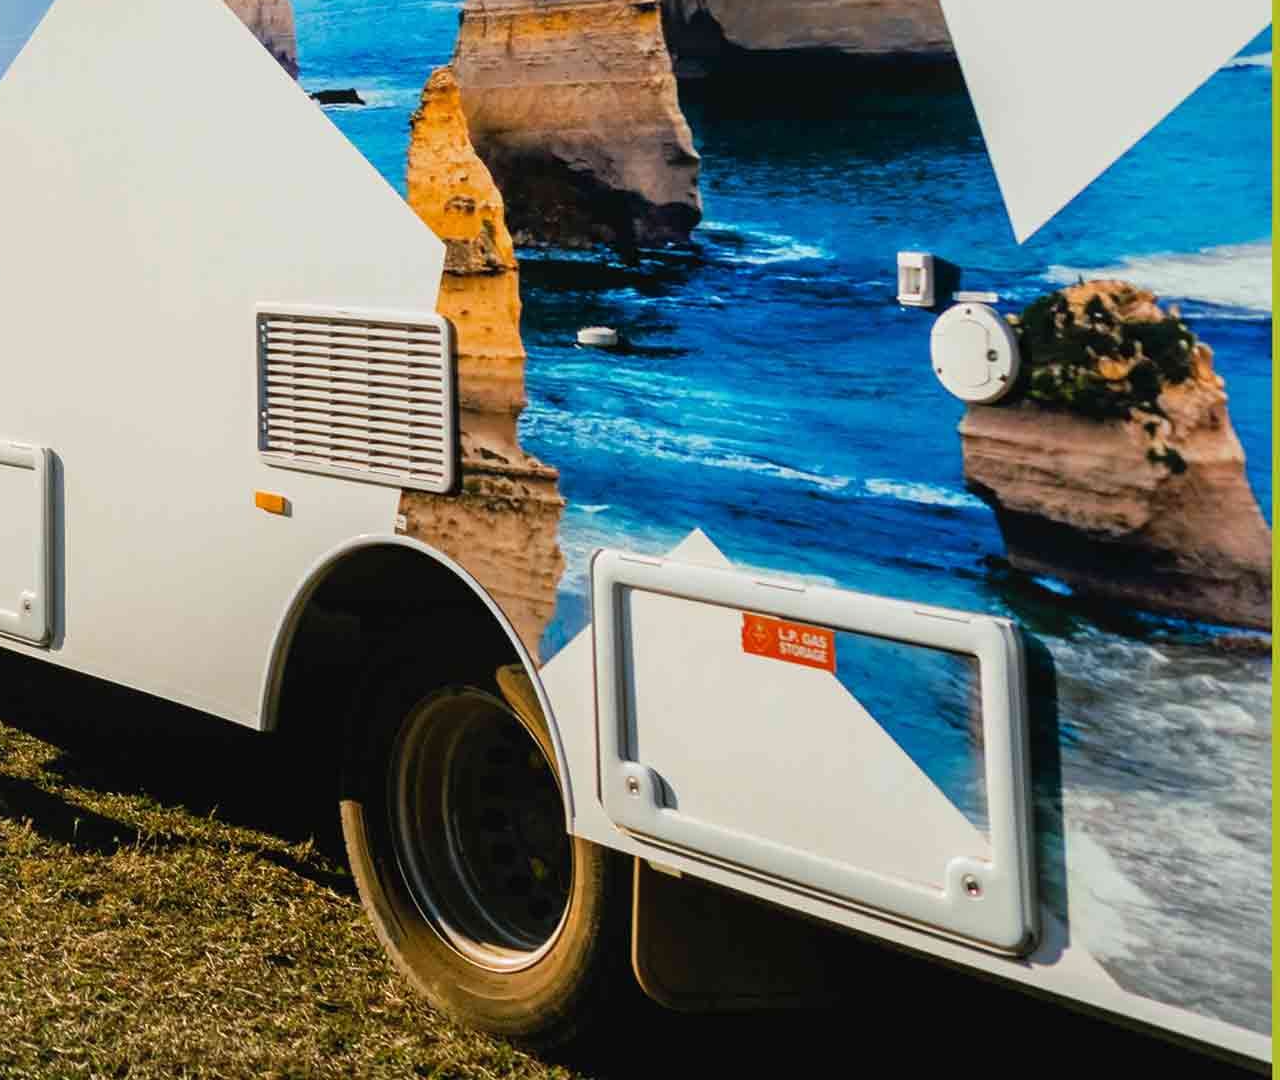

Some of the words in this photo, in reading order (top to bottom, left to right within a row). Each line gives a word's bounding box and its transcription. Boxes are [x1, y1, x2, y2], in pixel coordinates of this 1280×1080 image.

[778, 627, 800, 644] L.P.
[801, 632, 828, 649] GAS
[778, 642, 828, 664] STORAGE
